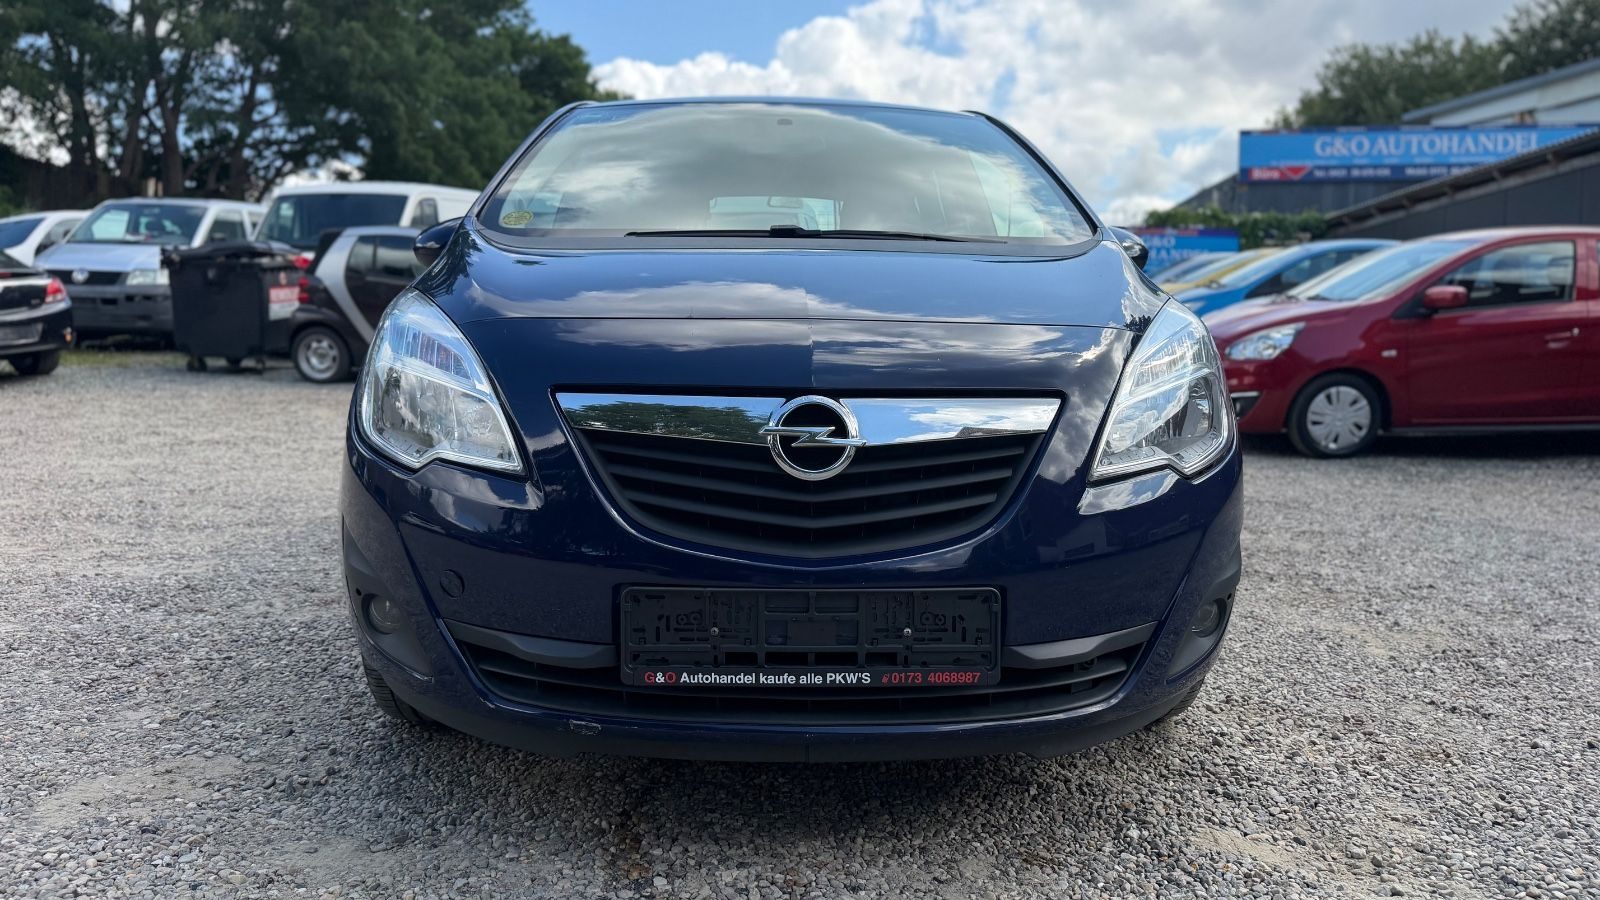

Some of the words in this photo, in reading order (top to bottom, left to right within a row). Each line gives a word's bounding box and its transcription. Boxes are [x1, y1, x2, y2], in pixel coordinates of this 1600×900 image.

[1314, 135, 1370, 157] G&O
[1372, 132, 1538, 155] AUTOHANDEL
[644, 672, 676, 684] G&O
[680, 672, 756, 685] Autohandel
[759, 673, 797, 685] kaufe
[799, 673, 823, 685] alle
[826, 672, 871, 685] PKW'S
[891, 672, 923, 684] 0173
[927, 672, 981, 684] 4068987
